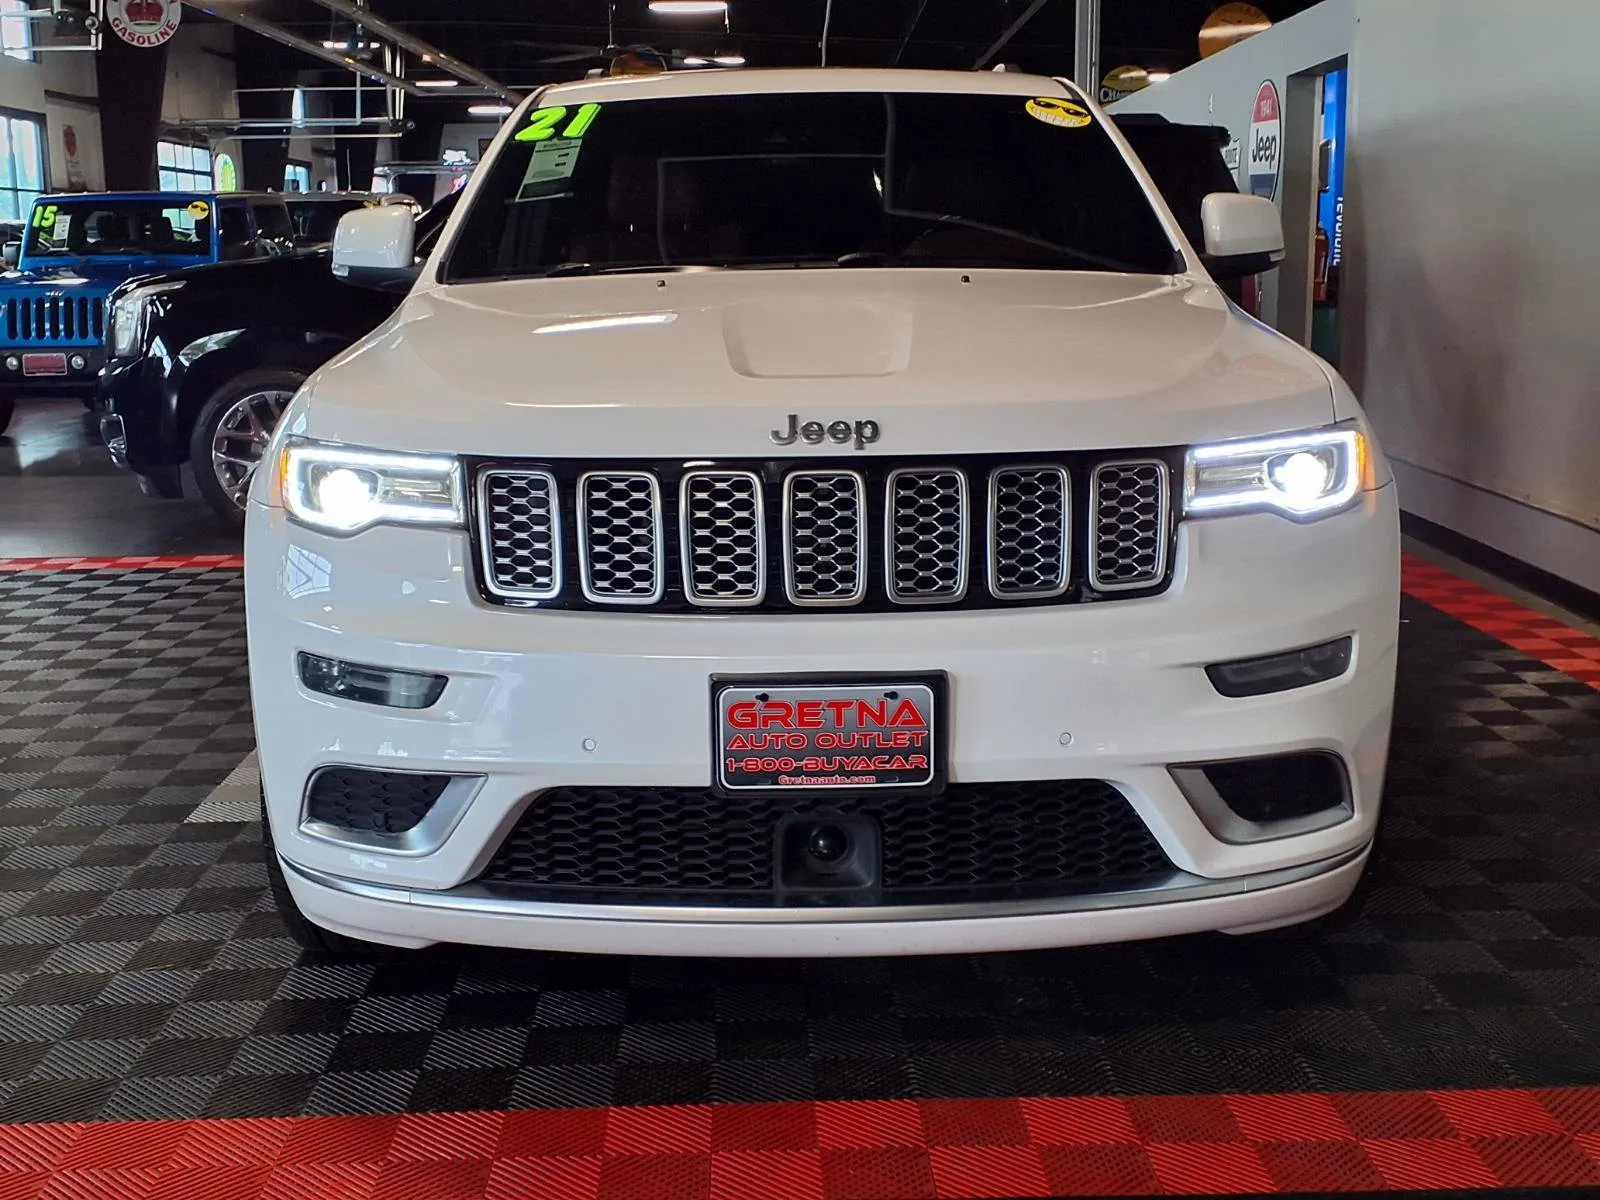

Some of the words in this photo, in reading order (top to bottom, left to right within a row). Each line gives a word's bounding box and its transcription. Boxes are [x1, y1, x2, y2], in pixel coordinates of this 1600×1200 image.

[112, 17, 176, 45] GASOLINE
[514, 103, 602, 142] 21
[1252, 127, 1277, 169] Jeep
[32, 205, 58, 228] 15
[768, 413, 880, 451] Jeep
[726, 697, 928, 730] GRETNA
[727, 733, 808, 750] AUTO
[814, 731, 929, 749] OUTLET
[726, 754, 928, 772] 1-800-BUYACAR
